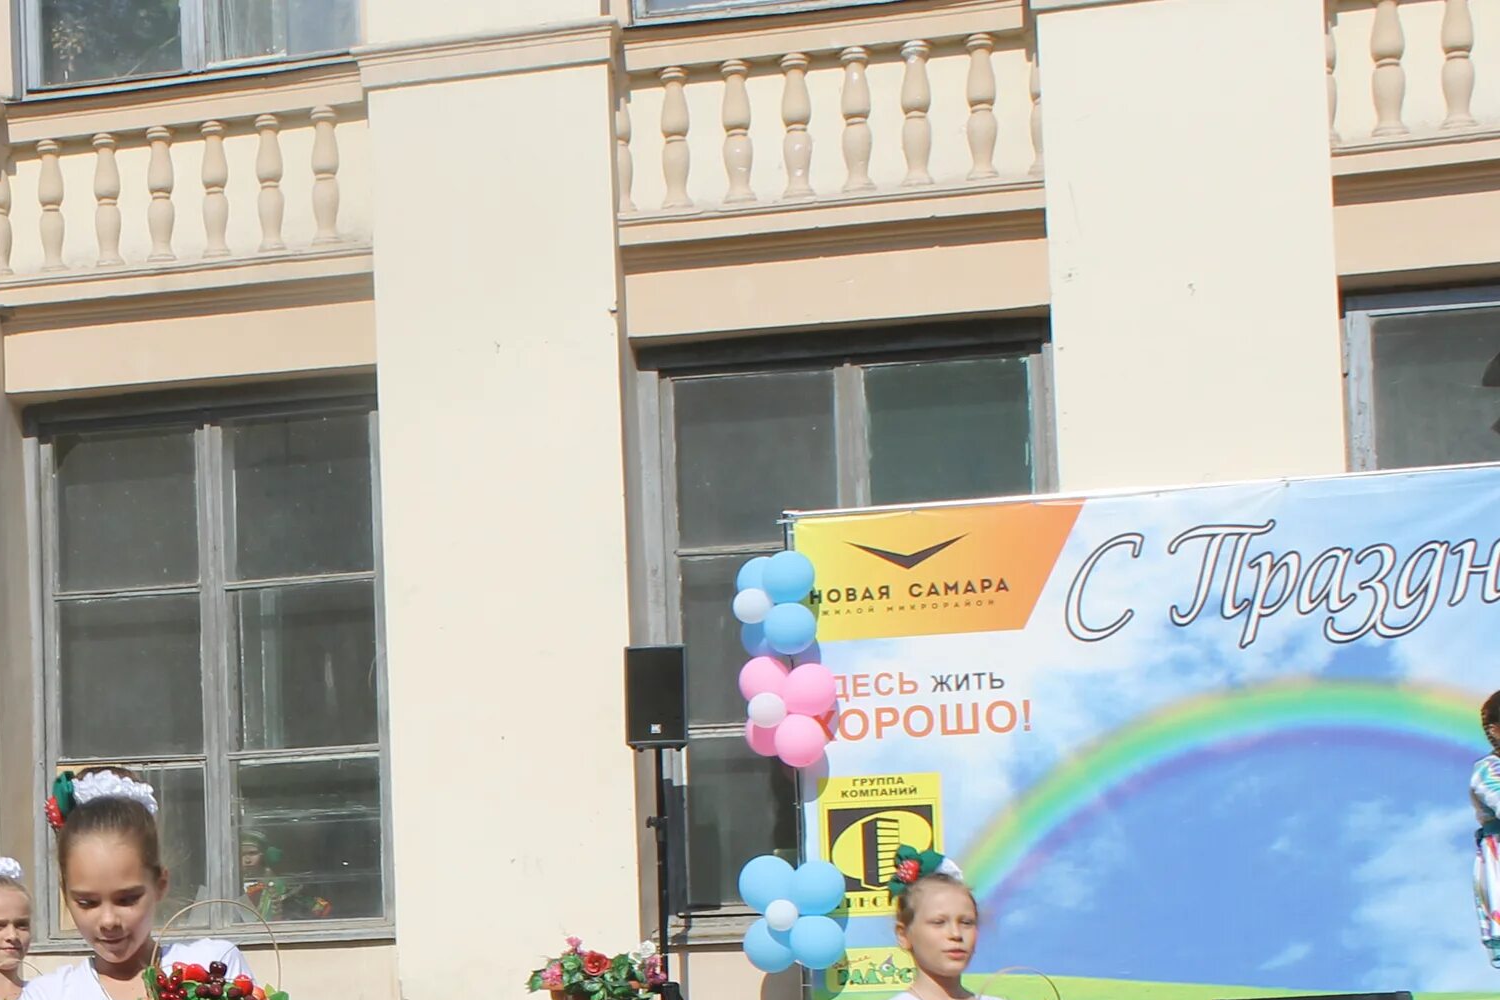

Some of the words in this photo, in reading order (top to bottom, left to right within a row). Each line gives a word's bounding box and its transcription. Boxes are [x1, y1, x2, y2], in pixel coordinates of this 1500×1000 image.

[809, 585, 891, 604] НОВАЯ
[907, 577, 1010, 599] САМАРА
[1064, 532, 1145, 643] С
[821, 606, 875, 617] ЖИЛОЙ
[886, 599, 995, 612] МИКРОРАЙОН
[833, 671, 920, 702] ДЕСЬ
[930, 672, 1006, 693] ЖИТЬ
[840, 785, 918, 798] КОМПАНИЙ
[852, 776, 905, 787] ГРУППА
